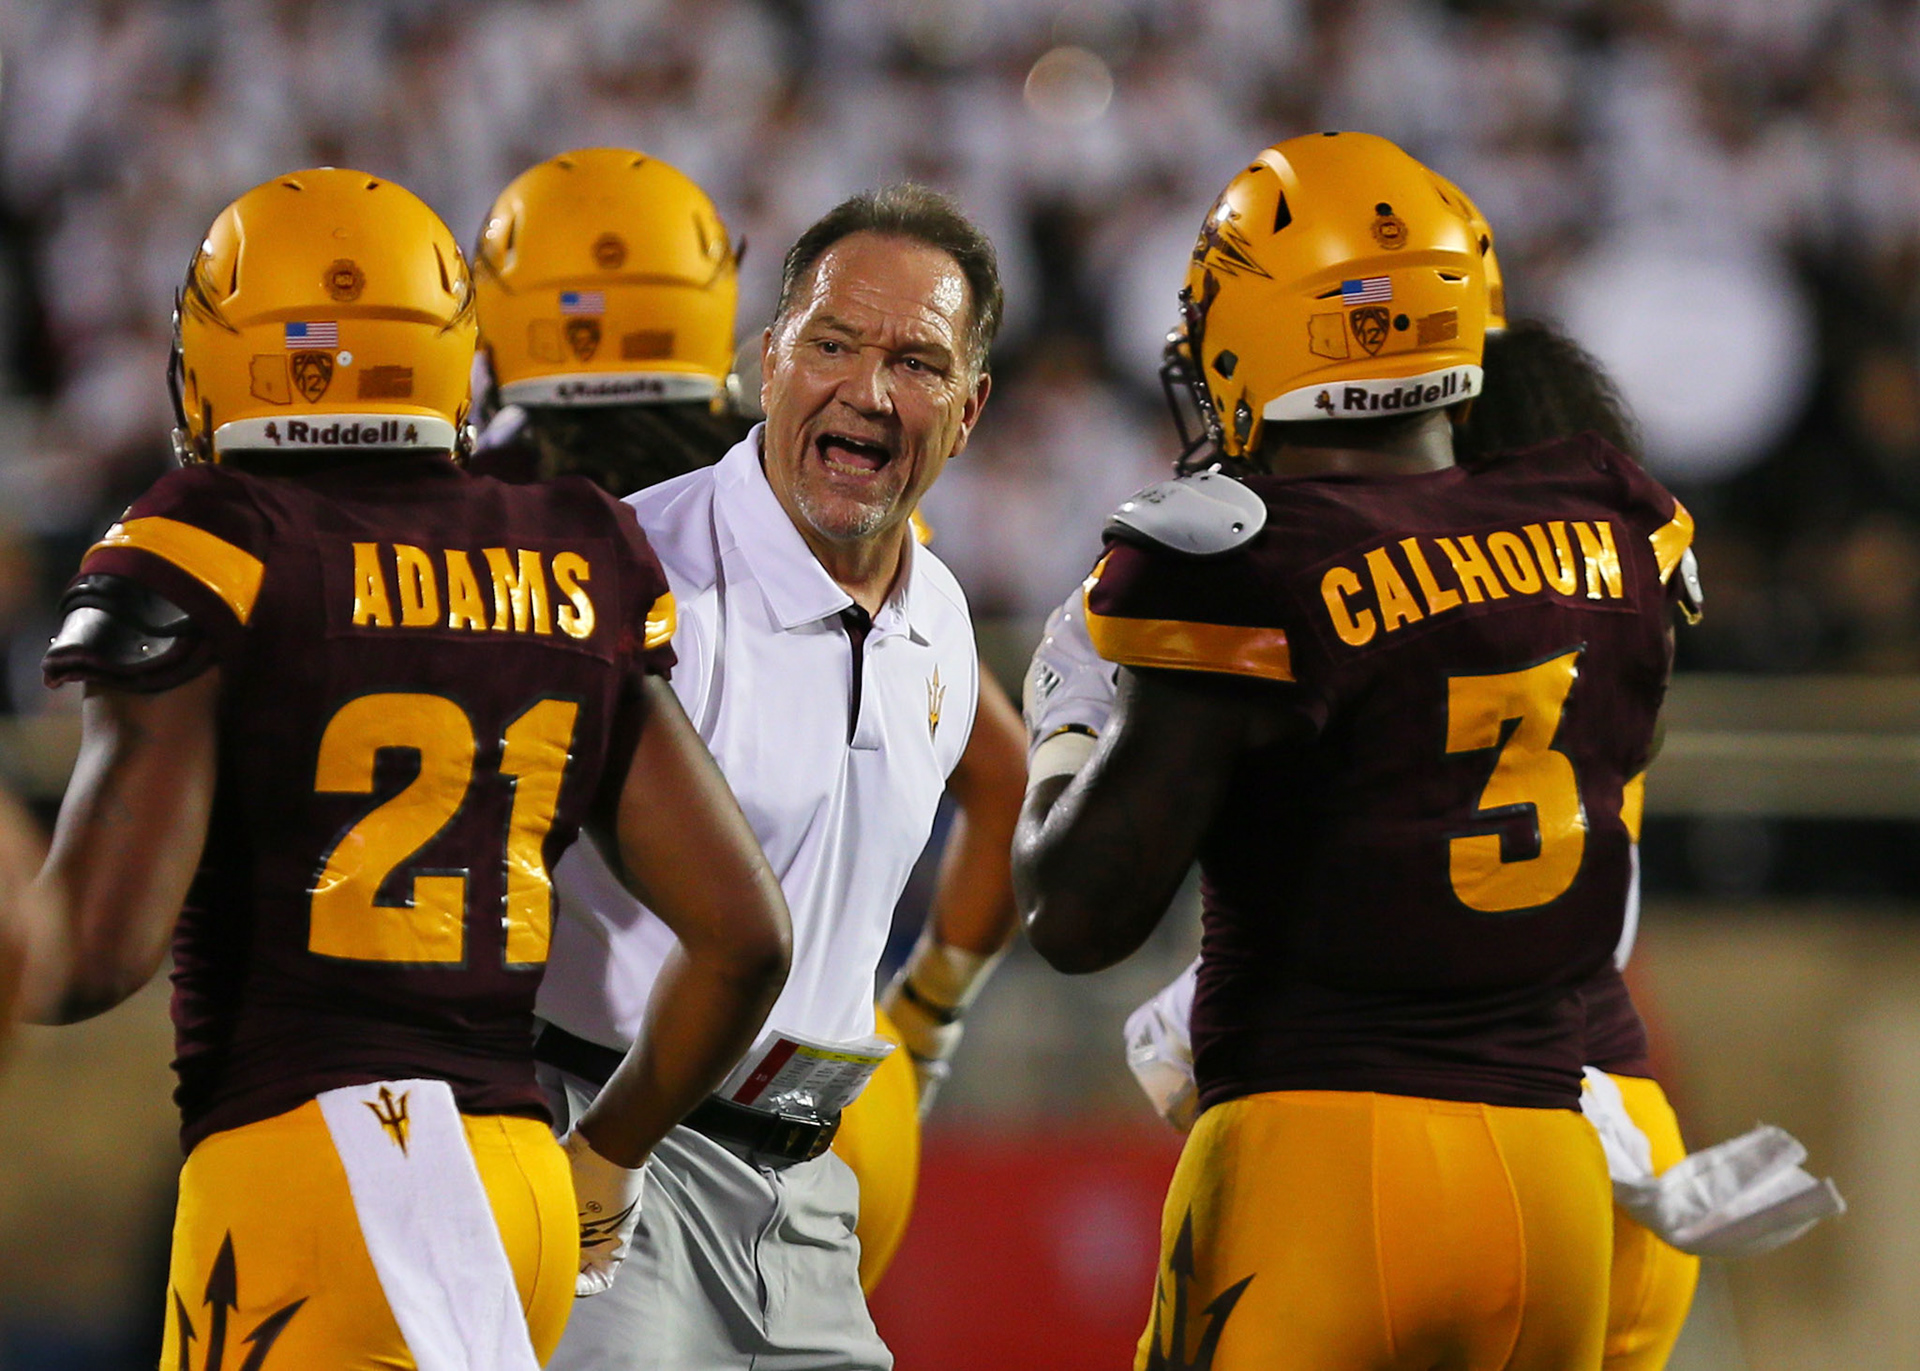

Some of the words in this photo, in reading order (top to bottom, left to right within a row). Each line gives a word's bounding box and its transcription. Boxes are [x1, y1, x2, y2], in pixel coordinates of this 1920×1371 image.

[288, 420, 398, 444] Riddell
[1343, 372, 1456, 410] Riddell
[352, 542, 595, 640] ADAMS
[1320, 521, 1623, 646] CALHOUN
[307, 691, 579, 965] 21
[1445, 645, 1588, 912] 3
